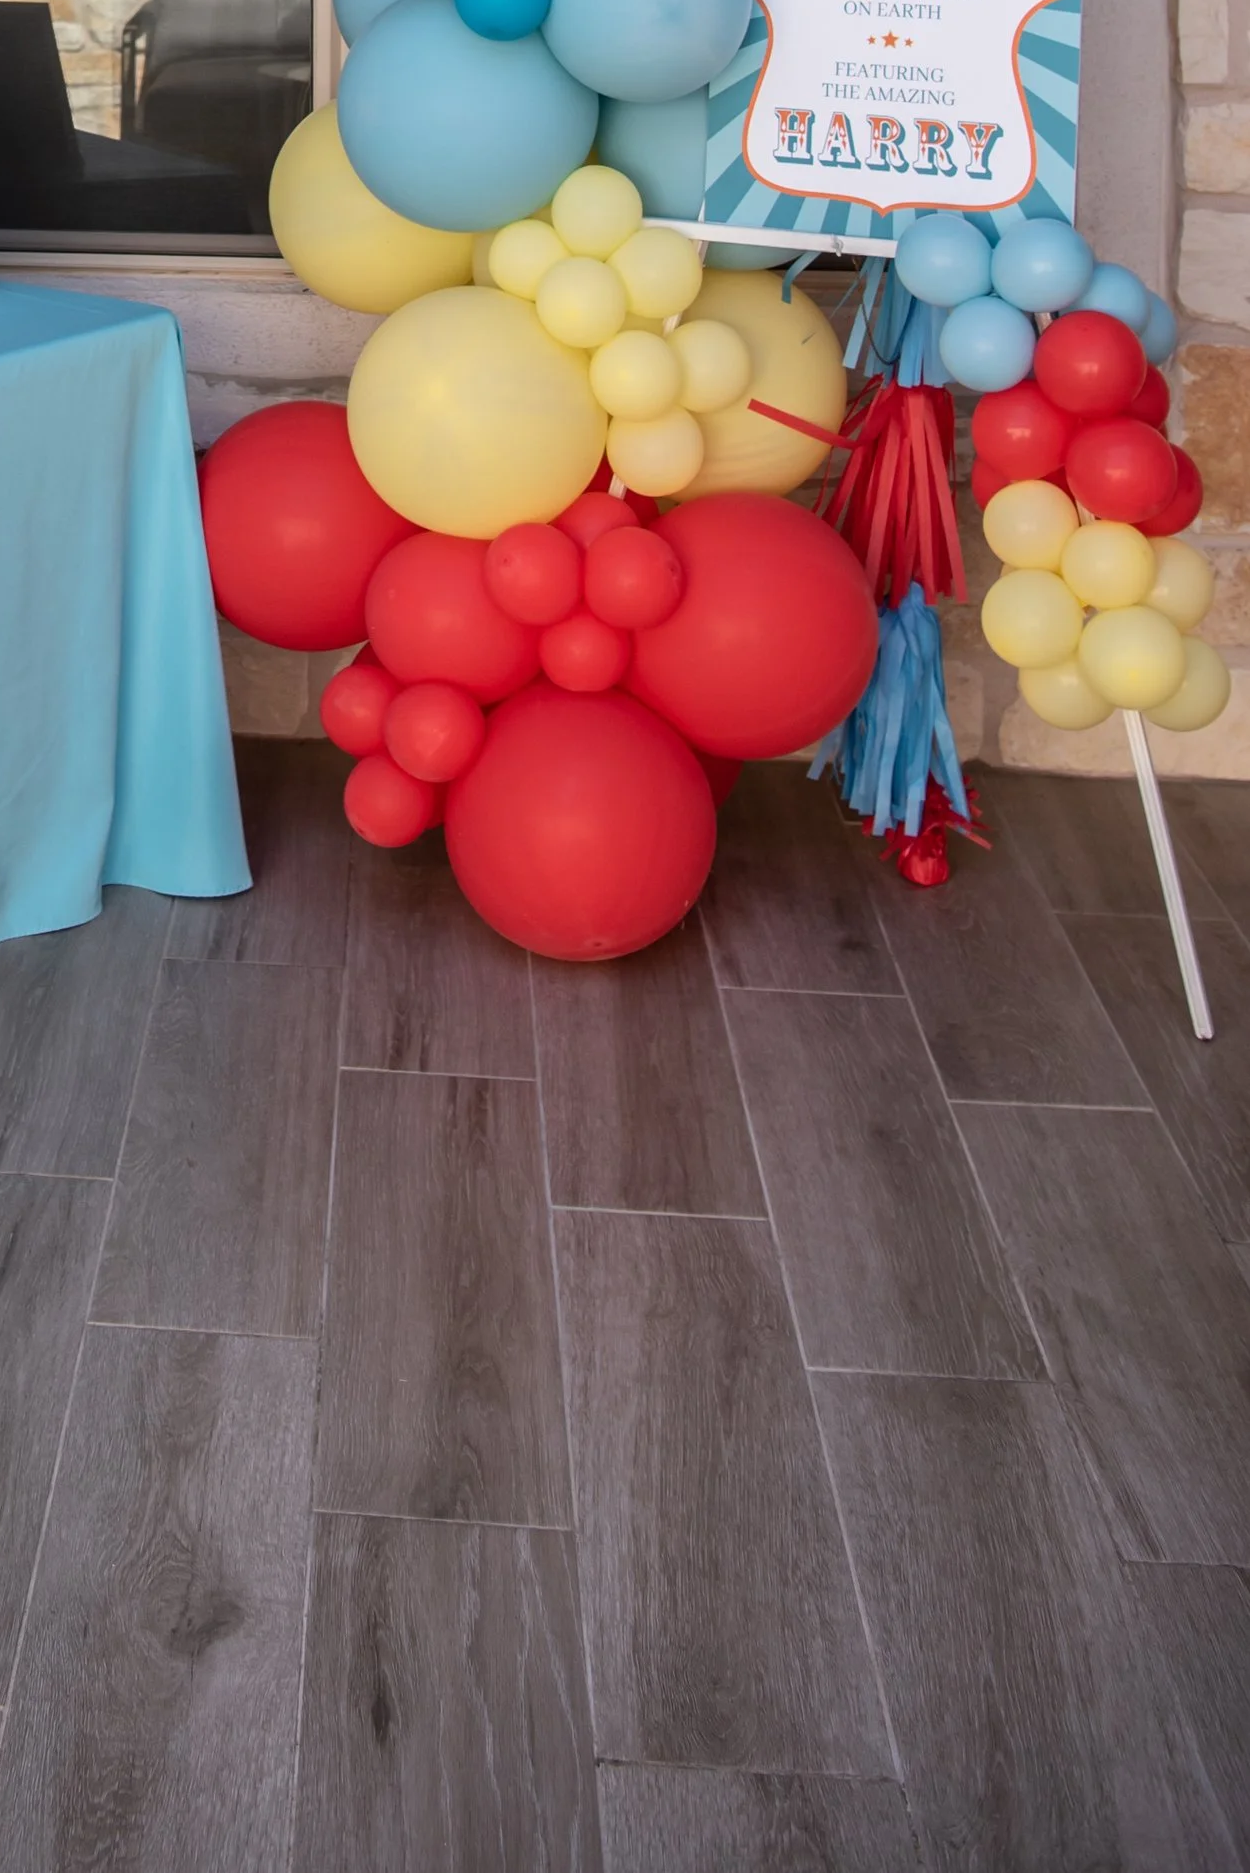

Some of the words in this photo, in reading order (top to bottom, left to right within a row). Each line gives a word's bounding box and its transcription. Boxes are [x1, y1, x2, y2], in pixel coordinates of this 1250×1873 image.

[843, 0, 872, 16] ON
[877, 1, 942, 20] EARTH
[835, 61, 944, 83] FEATURING
[822, 82, 860, 100] THE
[864, 86, 956, 106] AMAZING
[772, 106, 1004, 180] HARRY
